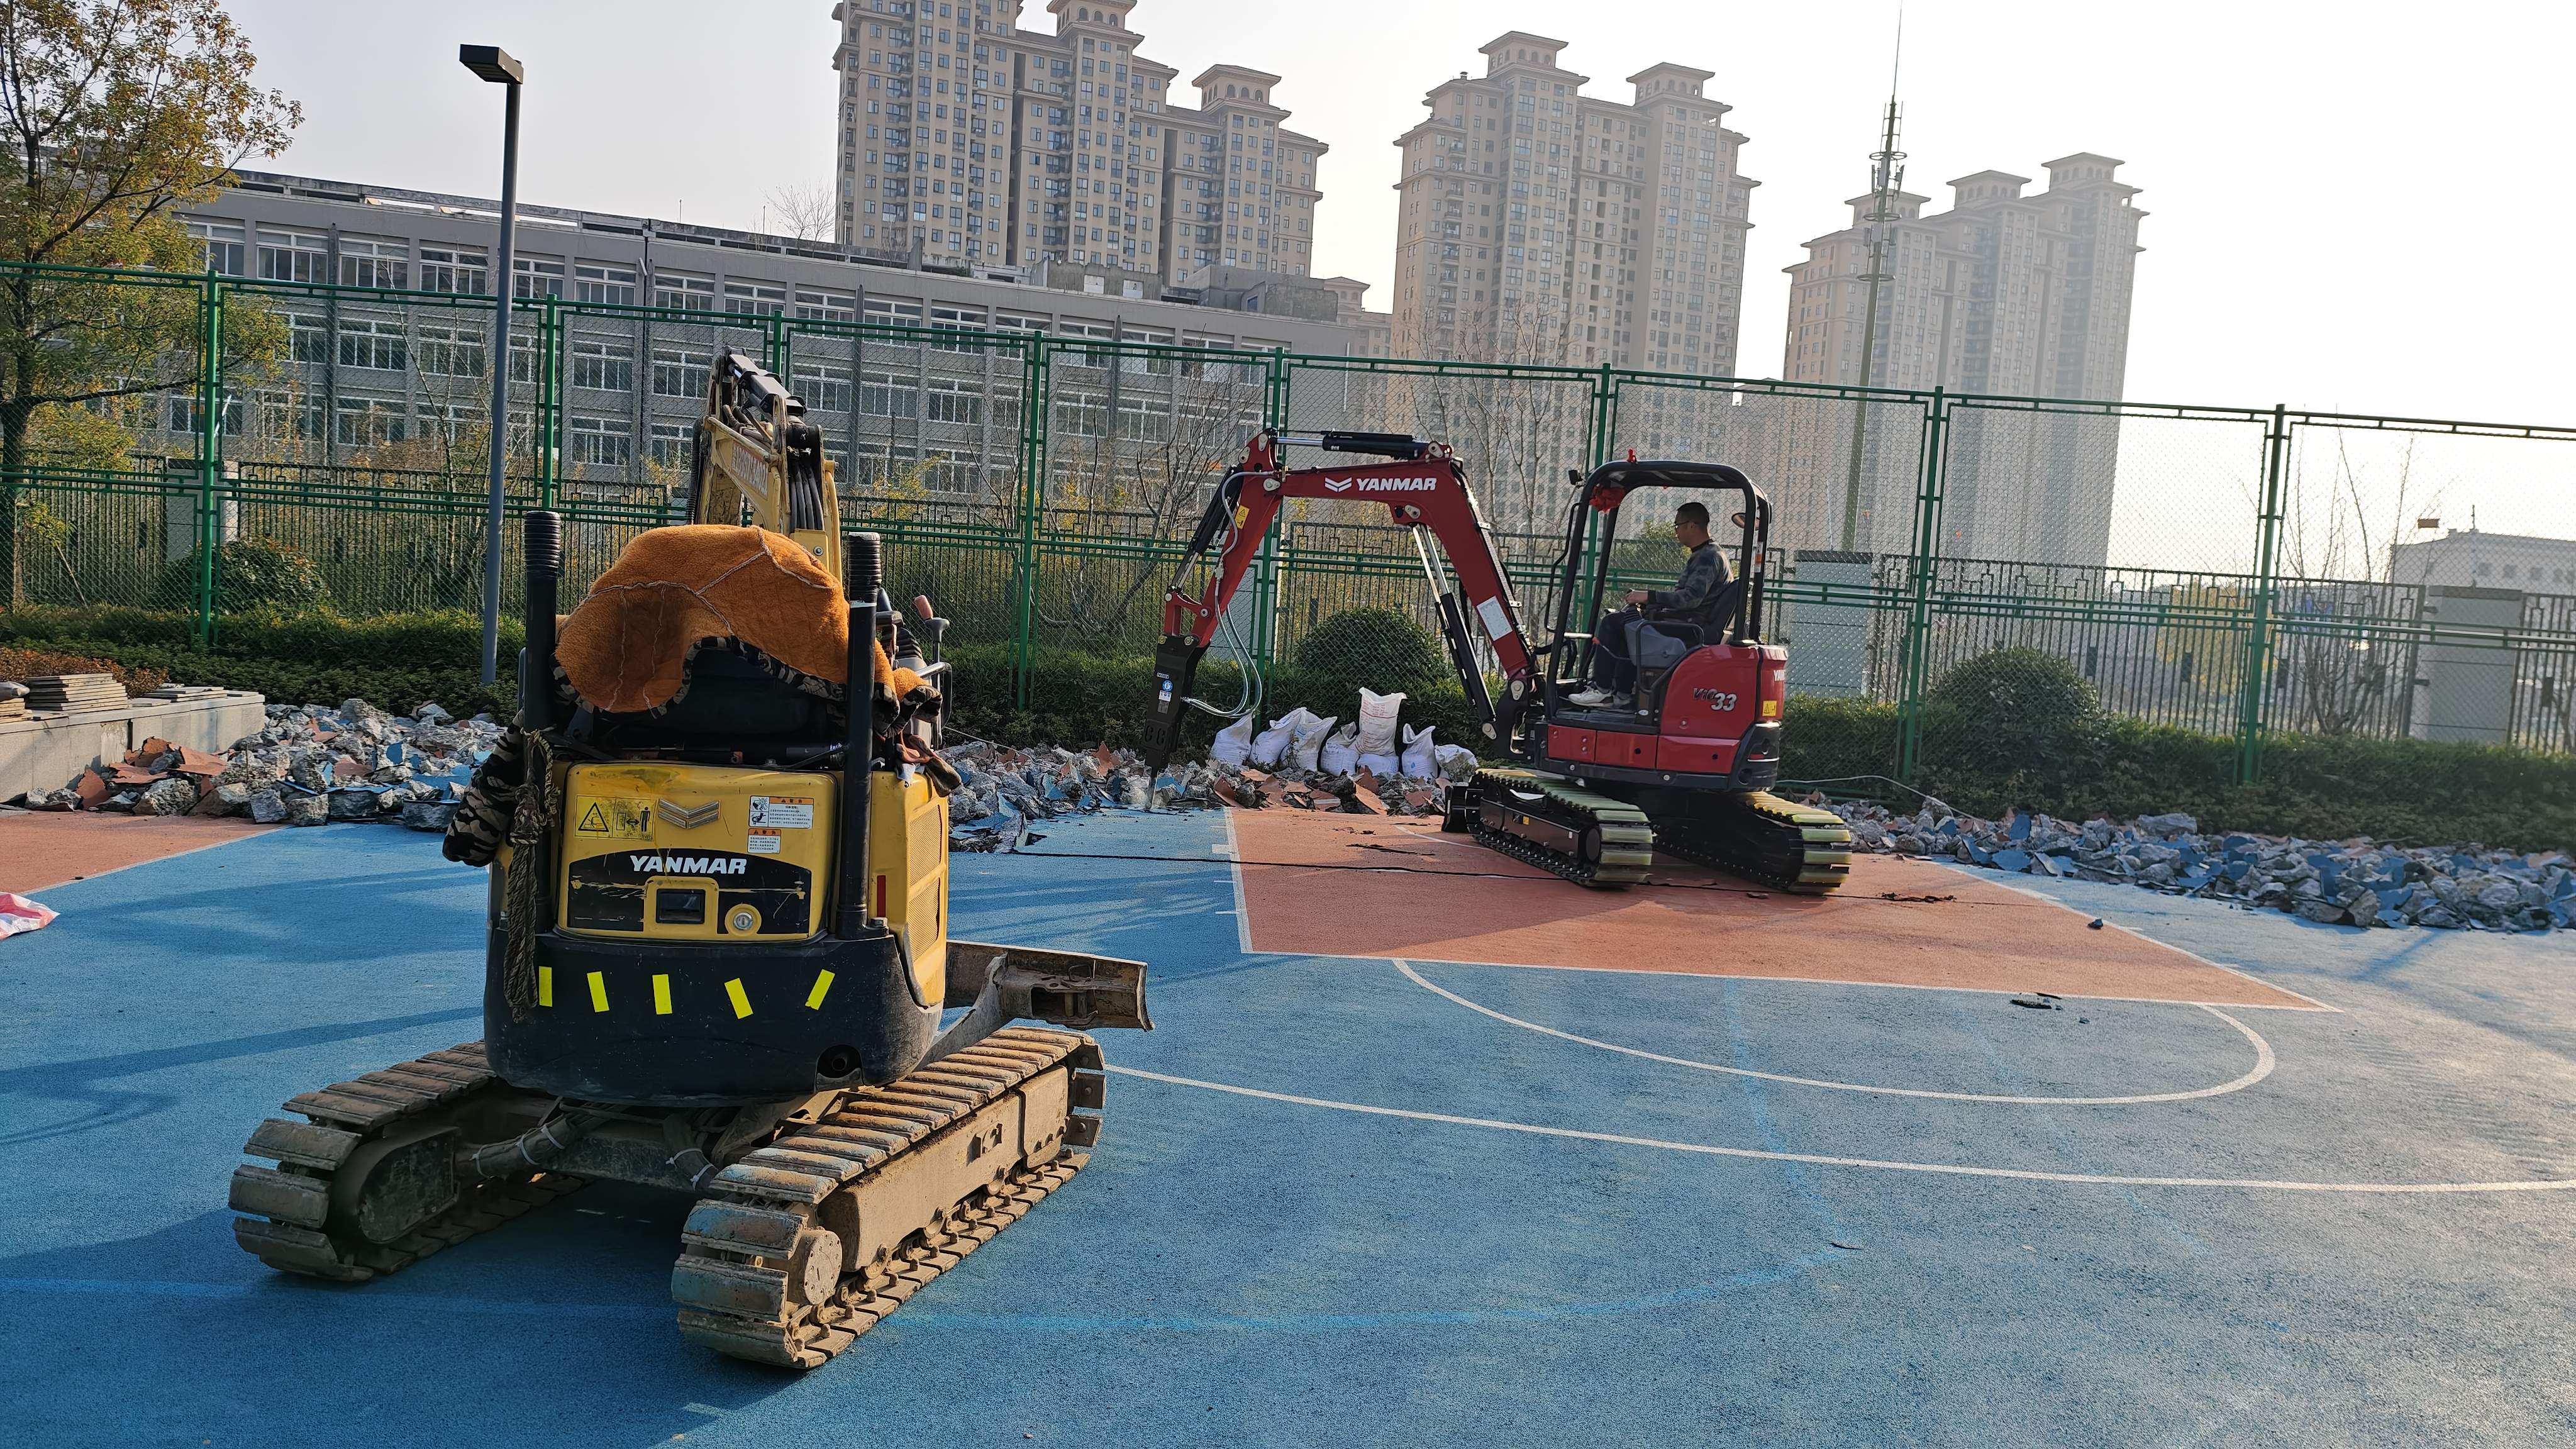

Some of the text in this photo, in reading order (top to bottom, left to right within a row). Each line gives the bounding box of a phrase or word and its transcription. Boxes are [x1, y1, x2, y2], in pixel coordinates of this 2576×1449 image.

[1356, 477, 1437, 491] YANMAR
[1711, 692, 1737, 711] 33
[630, 855, 747, 874] YANMAR
